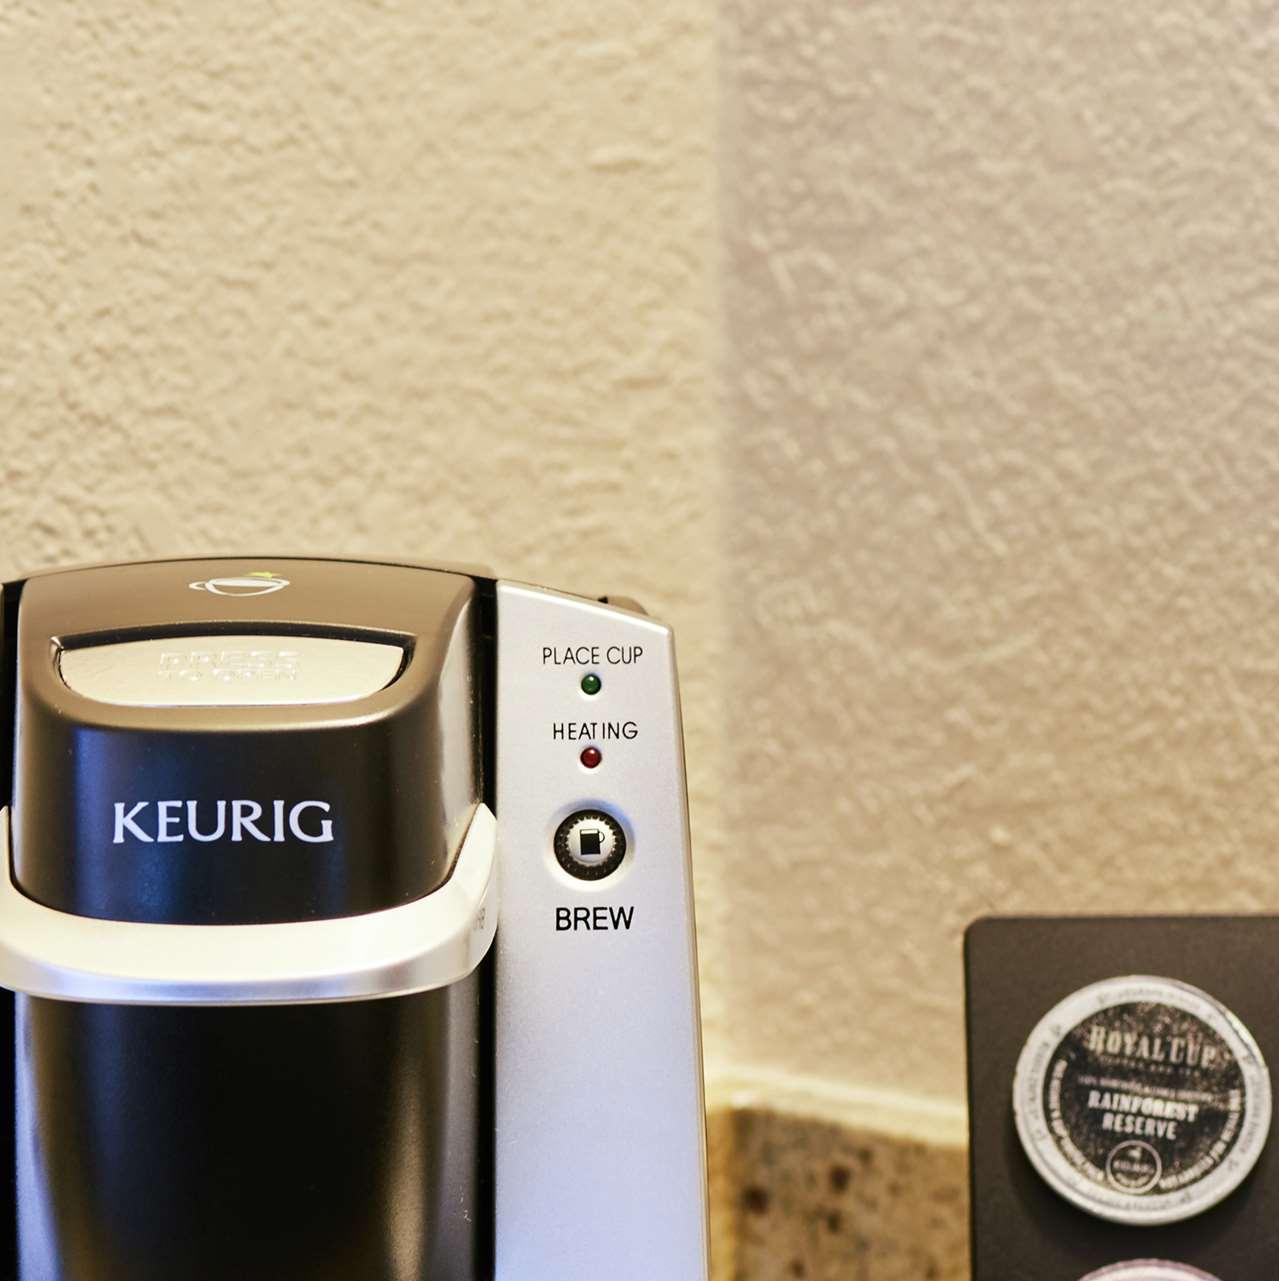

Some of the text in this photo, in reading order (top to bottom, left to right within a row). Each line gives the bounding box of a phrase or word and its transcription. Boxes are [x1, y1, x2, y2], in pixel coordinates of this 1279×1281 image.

[542, 646, 644, 665] PLACE CUP
[552, 721, 639, 740] HEATING
[112, 799, 335, 844] KEURIG
[555, 905, 635, 931] BREW
[1088, 1025, 1218, 1070] ROYAL CUP
[1087, 1089, 1200, 1123] RAINFOREST
[1102, 1112, 1178, 1140] RESERVE
